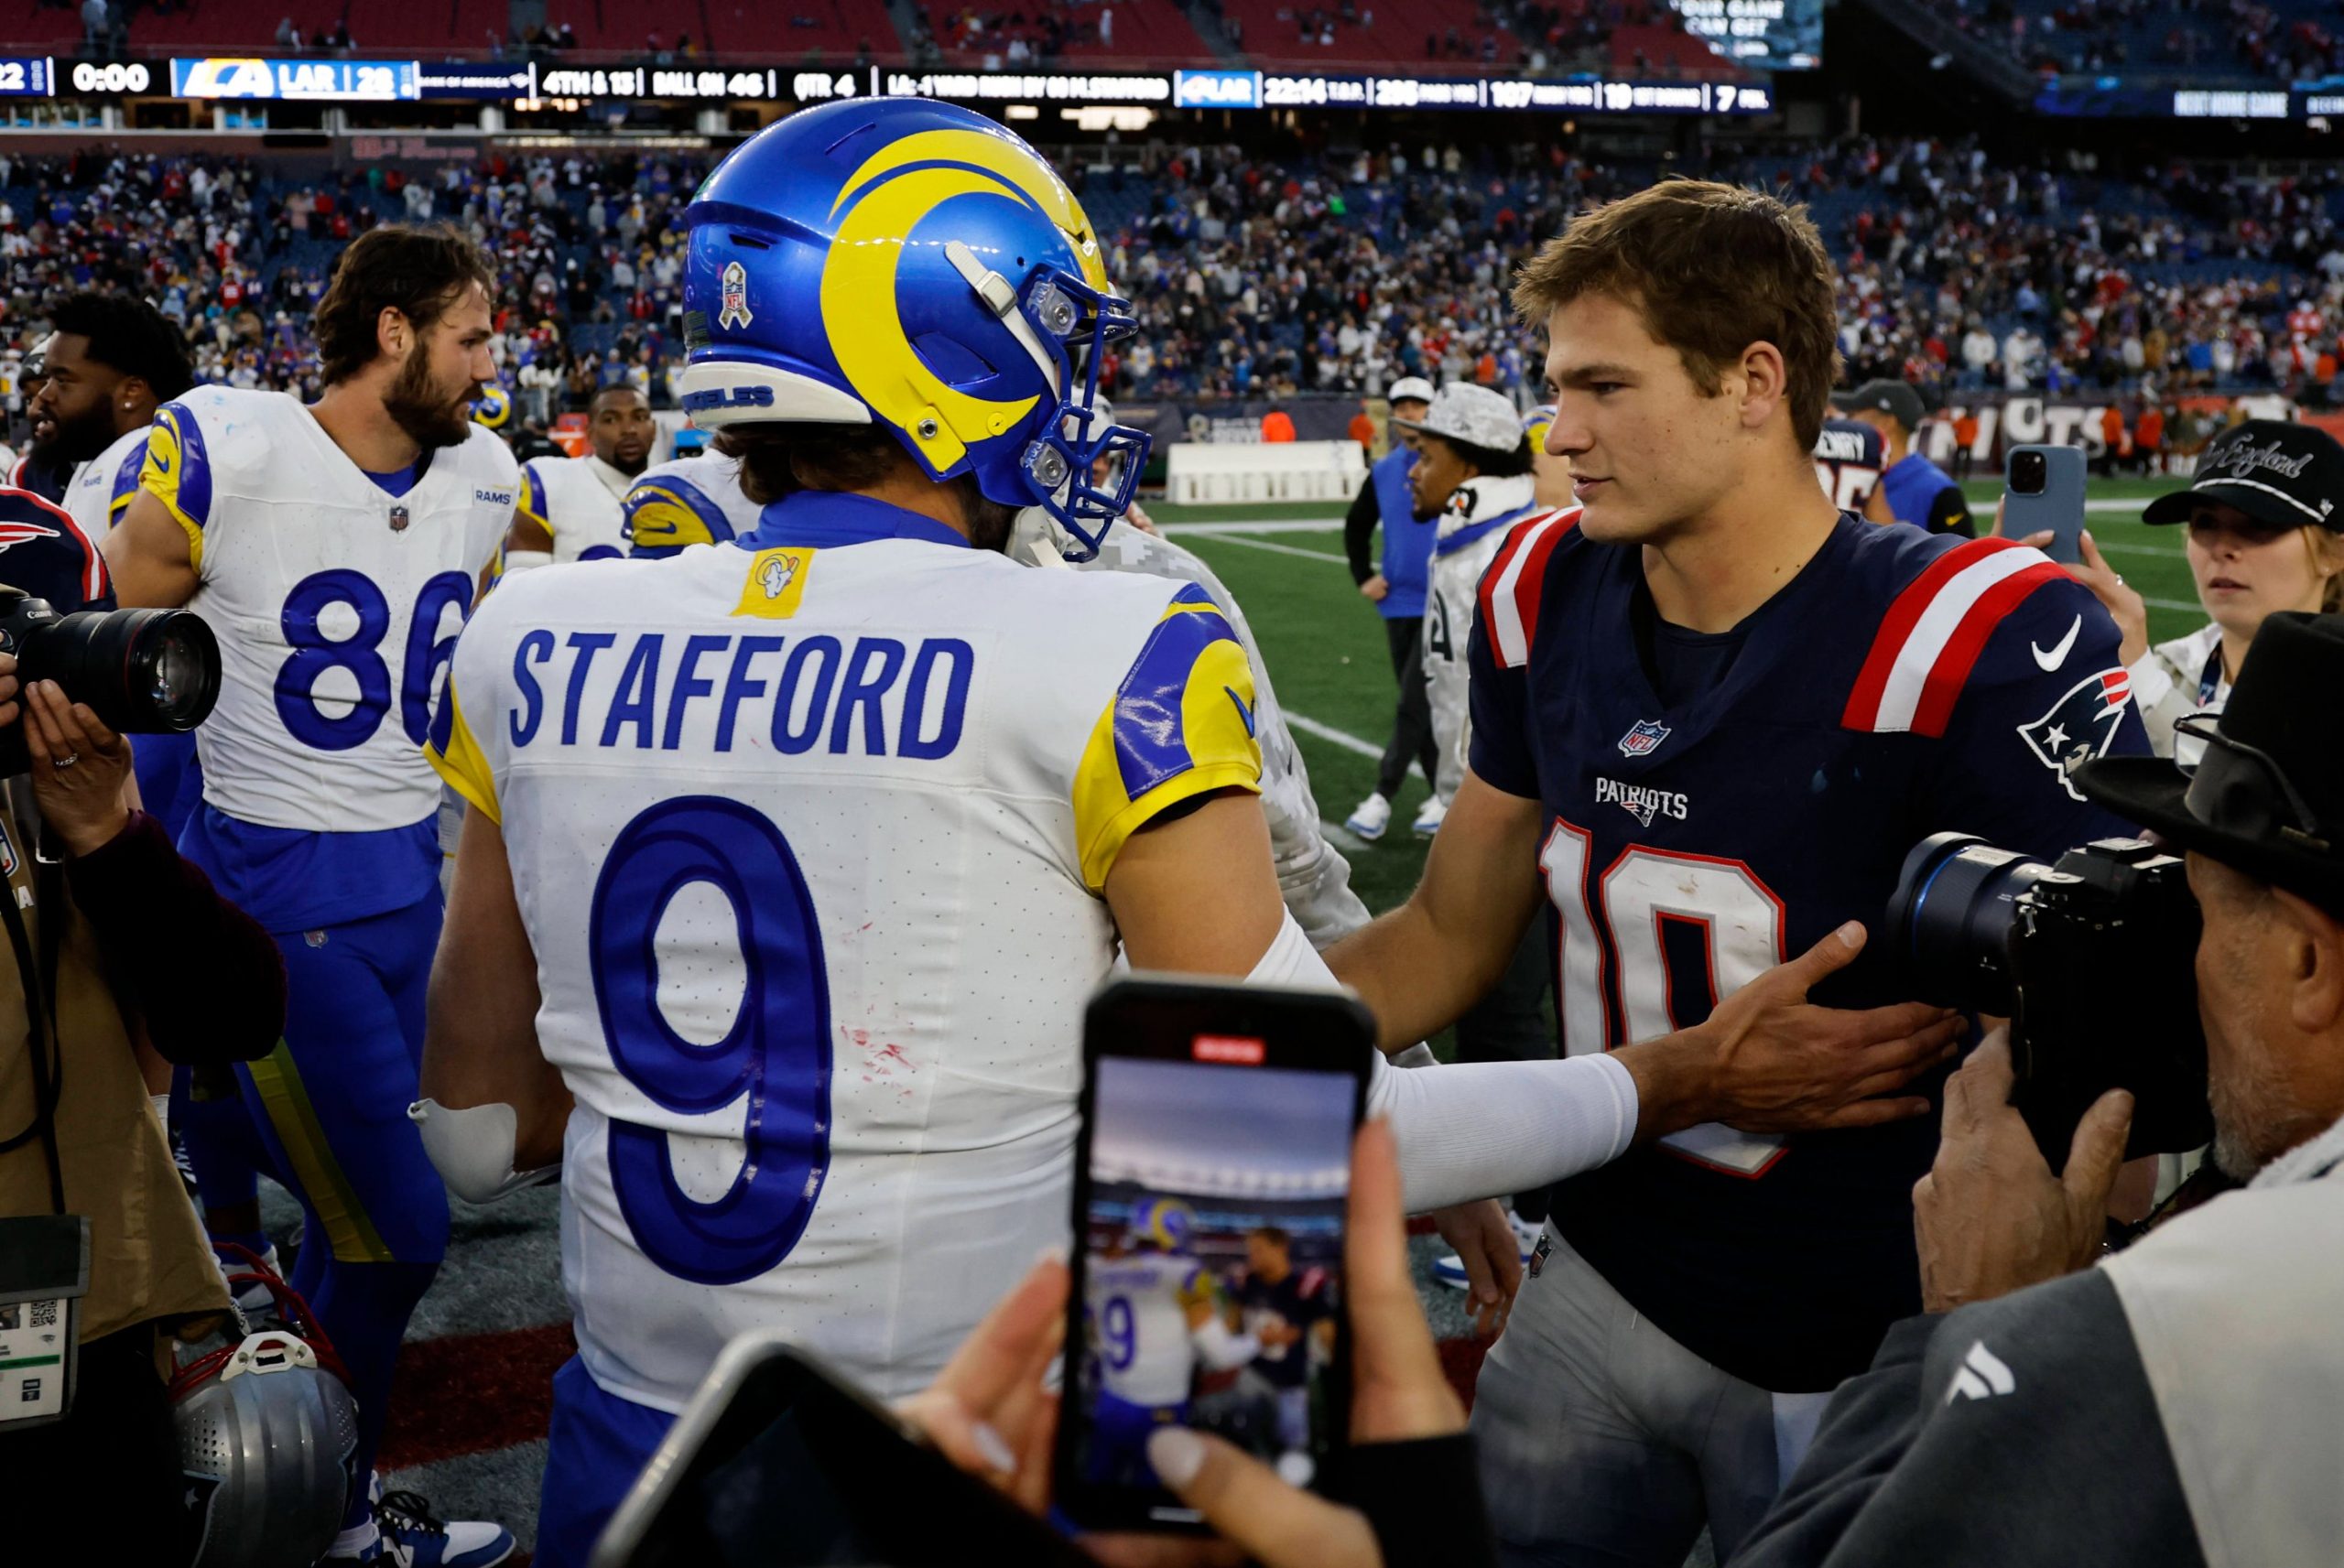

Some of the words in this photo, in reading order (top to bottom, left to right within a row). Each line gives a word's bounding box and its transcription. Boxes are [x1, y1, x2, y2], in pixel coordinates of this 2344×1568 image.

[72, 62, 150, 92] 0:00
[278, 64, 335, 92] LAR
[543, 70, 591, 95] 4TH
[834, 74, 856, 97] 4
[1716, 85, 1737, 112] 7
[726, 293, 743, 308] NFL
[475, 490, 511, 505] RAMS
[27, 611, 52, 619] Canon
[275, 568, 474, 751] 86
[509, 629, 975, 761] STAFFORD
[1626, 734, 1652, 751] NFL
[1596, 777, 1688, 820] PATRIOTS
[1538, 816, 1790, 1181] 10
[589, 795, 834, 1285] 9
